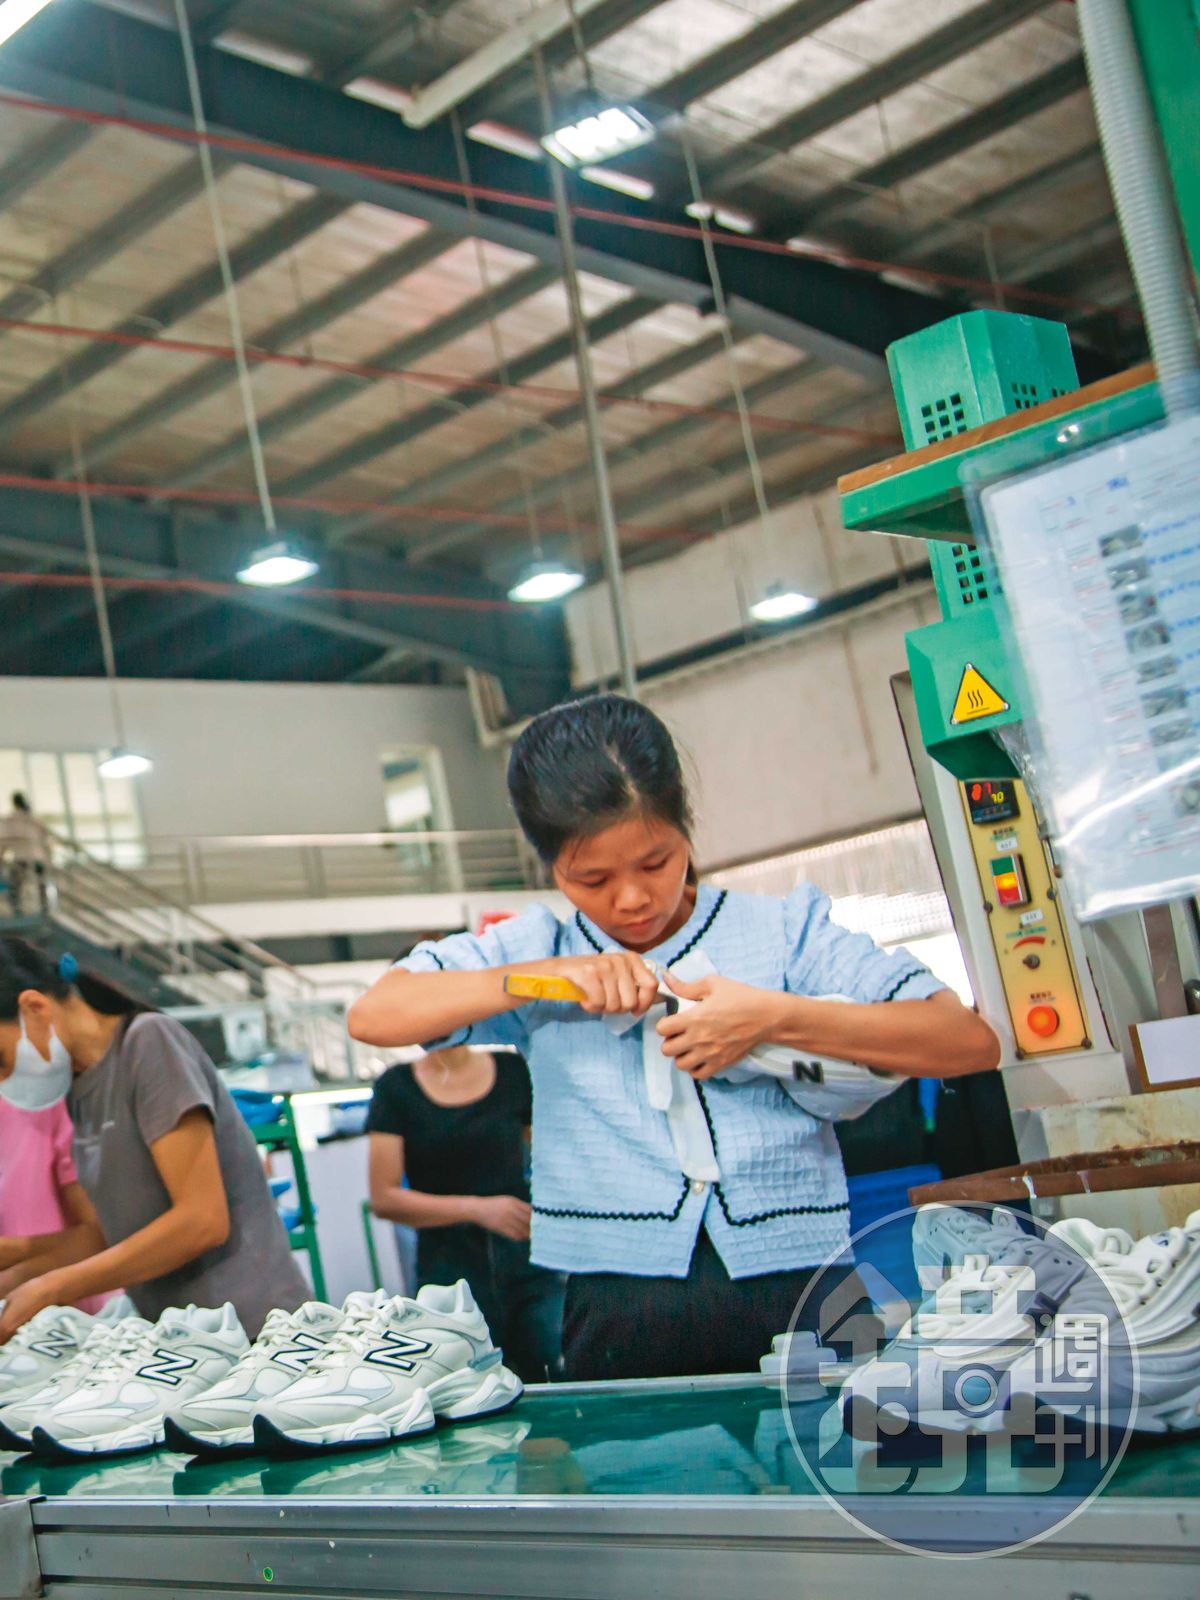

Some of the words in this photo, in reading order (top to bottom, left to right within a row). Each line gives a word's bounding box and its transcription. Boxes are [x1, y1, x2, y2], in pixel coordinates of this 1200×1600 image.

[793, 1060, 825, 1085] N
[28, 1329, 78, 1359] N
[363, 1330, 433, 1372] N
[136, 1348, 198, 1386] N
